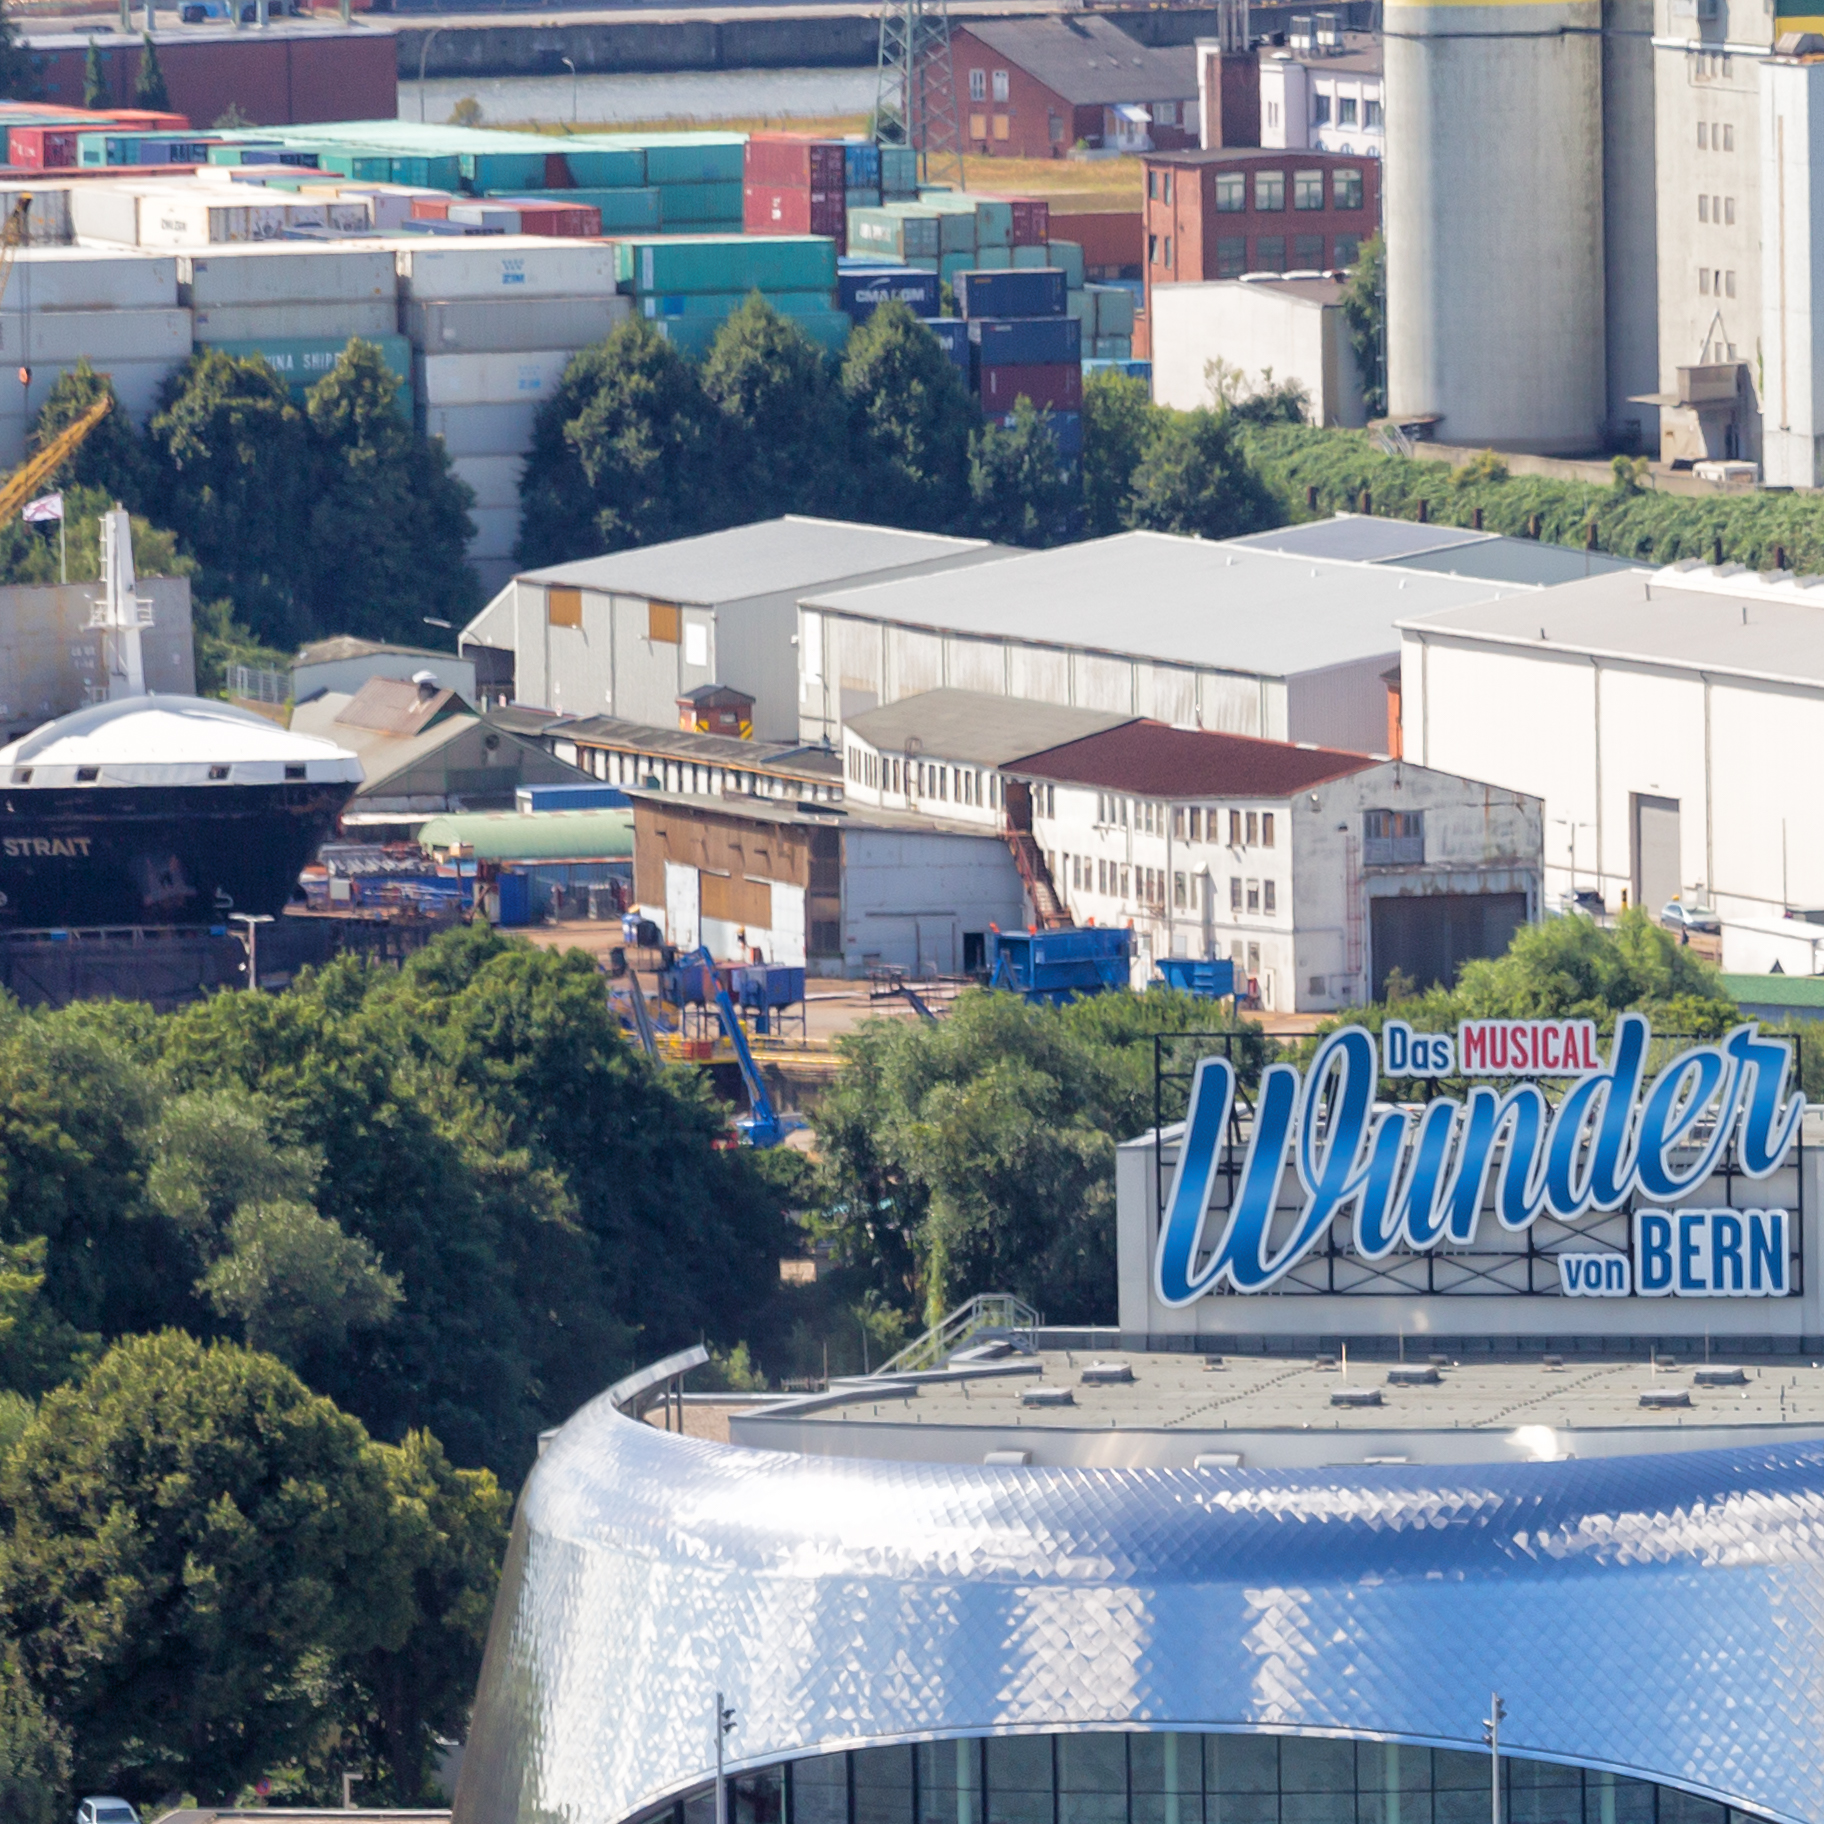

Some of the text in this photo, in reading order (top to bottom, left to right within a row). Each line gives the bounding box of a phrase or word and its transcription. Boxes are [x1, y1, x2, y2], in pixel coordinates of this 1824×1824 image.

[3, 836, 92, 857] STRAIT
[1389, 1026, 1598, 1072] Das MUSICAL
[1160, 1014, 1803, 1308] Wunder
[1562, 1213, 1784, 1293] von BERN
